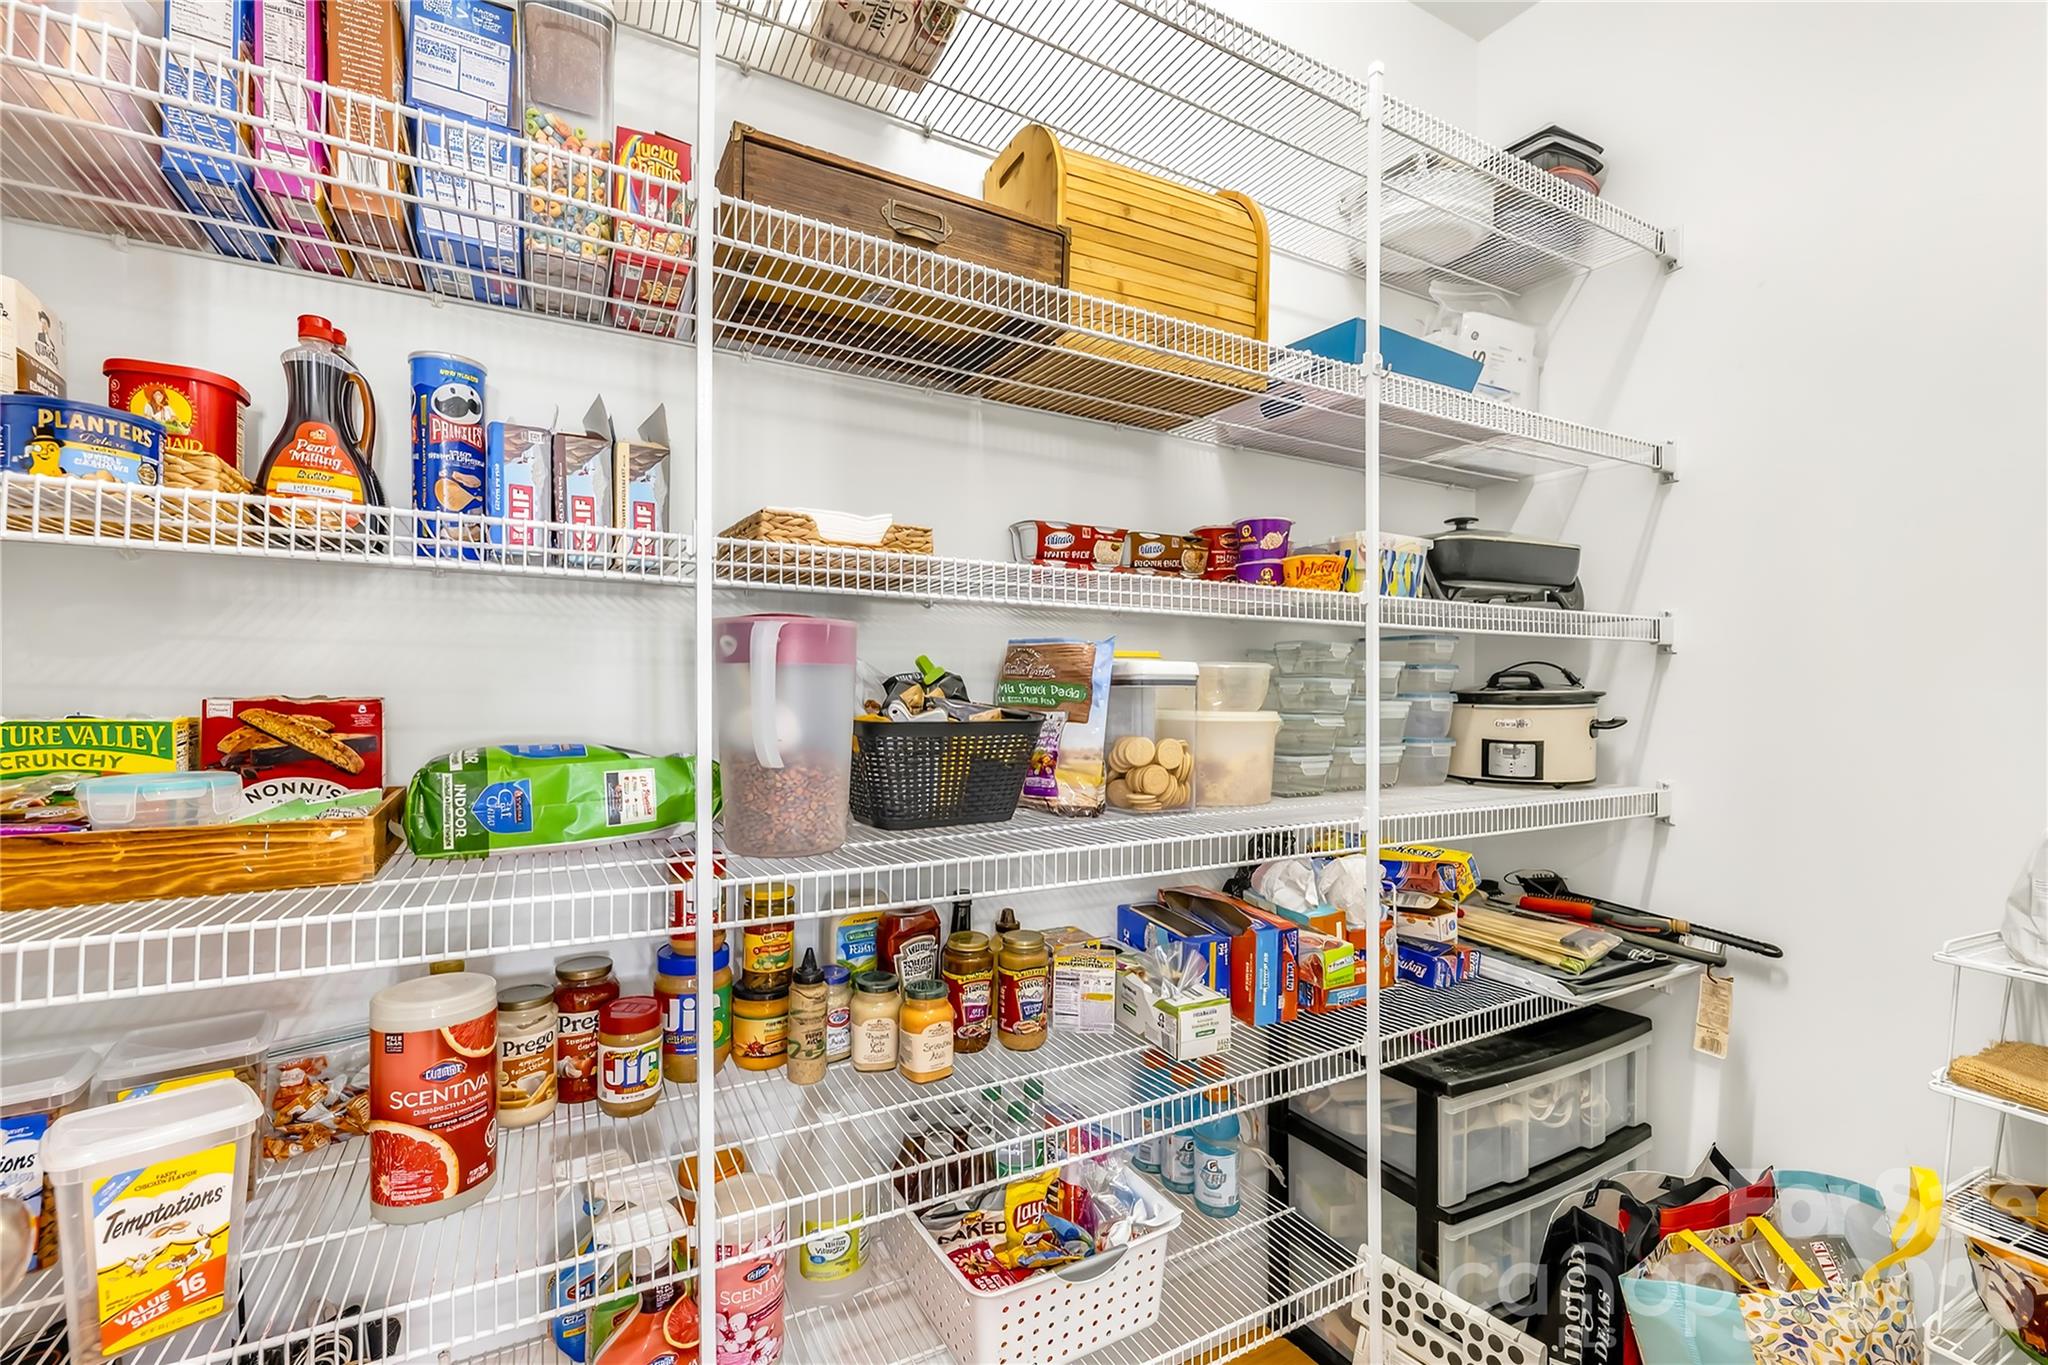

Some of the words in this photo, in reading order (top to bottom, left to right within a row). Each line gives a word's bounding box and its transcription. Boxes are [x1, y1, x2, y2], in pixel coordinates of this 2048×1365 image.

[38, 409, 153, 448] PLANTERS
[65, 725, 166, 756] VALLEY
[0, 753, 124, 770] CRUNCHY
[454, 783, 467, 838] INDOOR
[558, 1011, 600, 1034] Preg
[502, 1030, 554, 1058] Prego
[389, 1071, 489, 1110] SCENTIVA
[103, 1186, 223, 1244] Temptations
[175, 1271, 208, 1298] 16
[114, 1290, 172, 1326] VALUE
[131, 1301, 171, 1329] SIZE
[1594, 1288, 1612, 1363] DEALS
